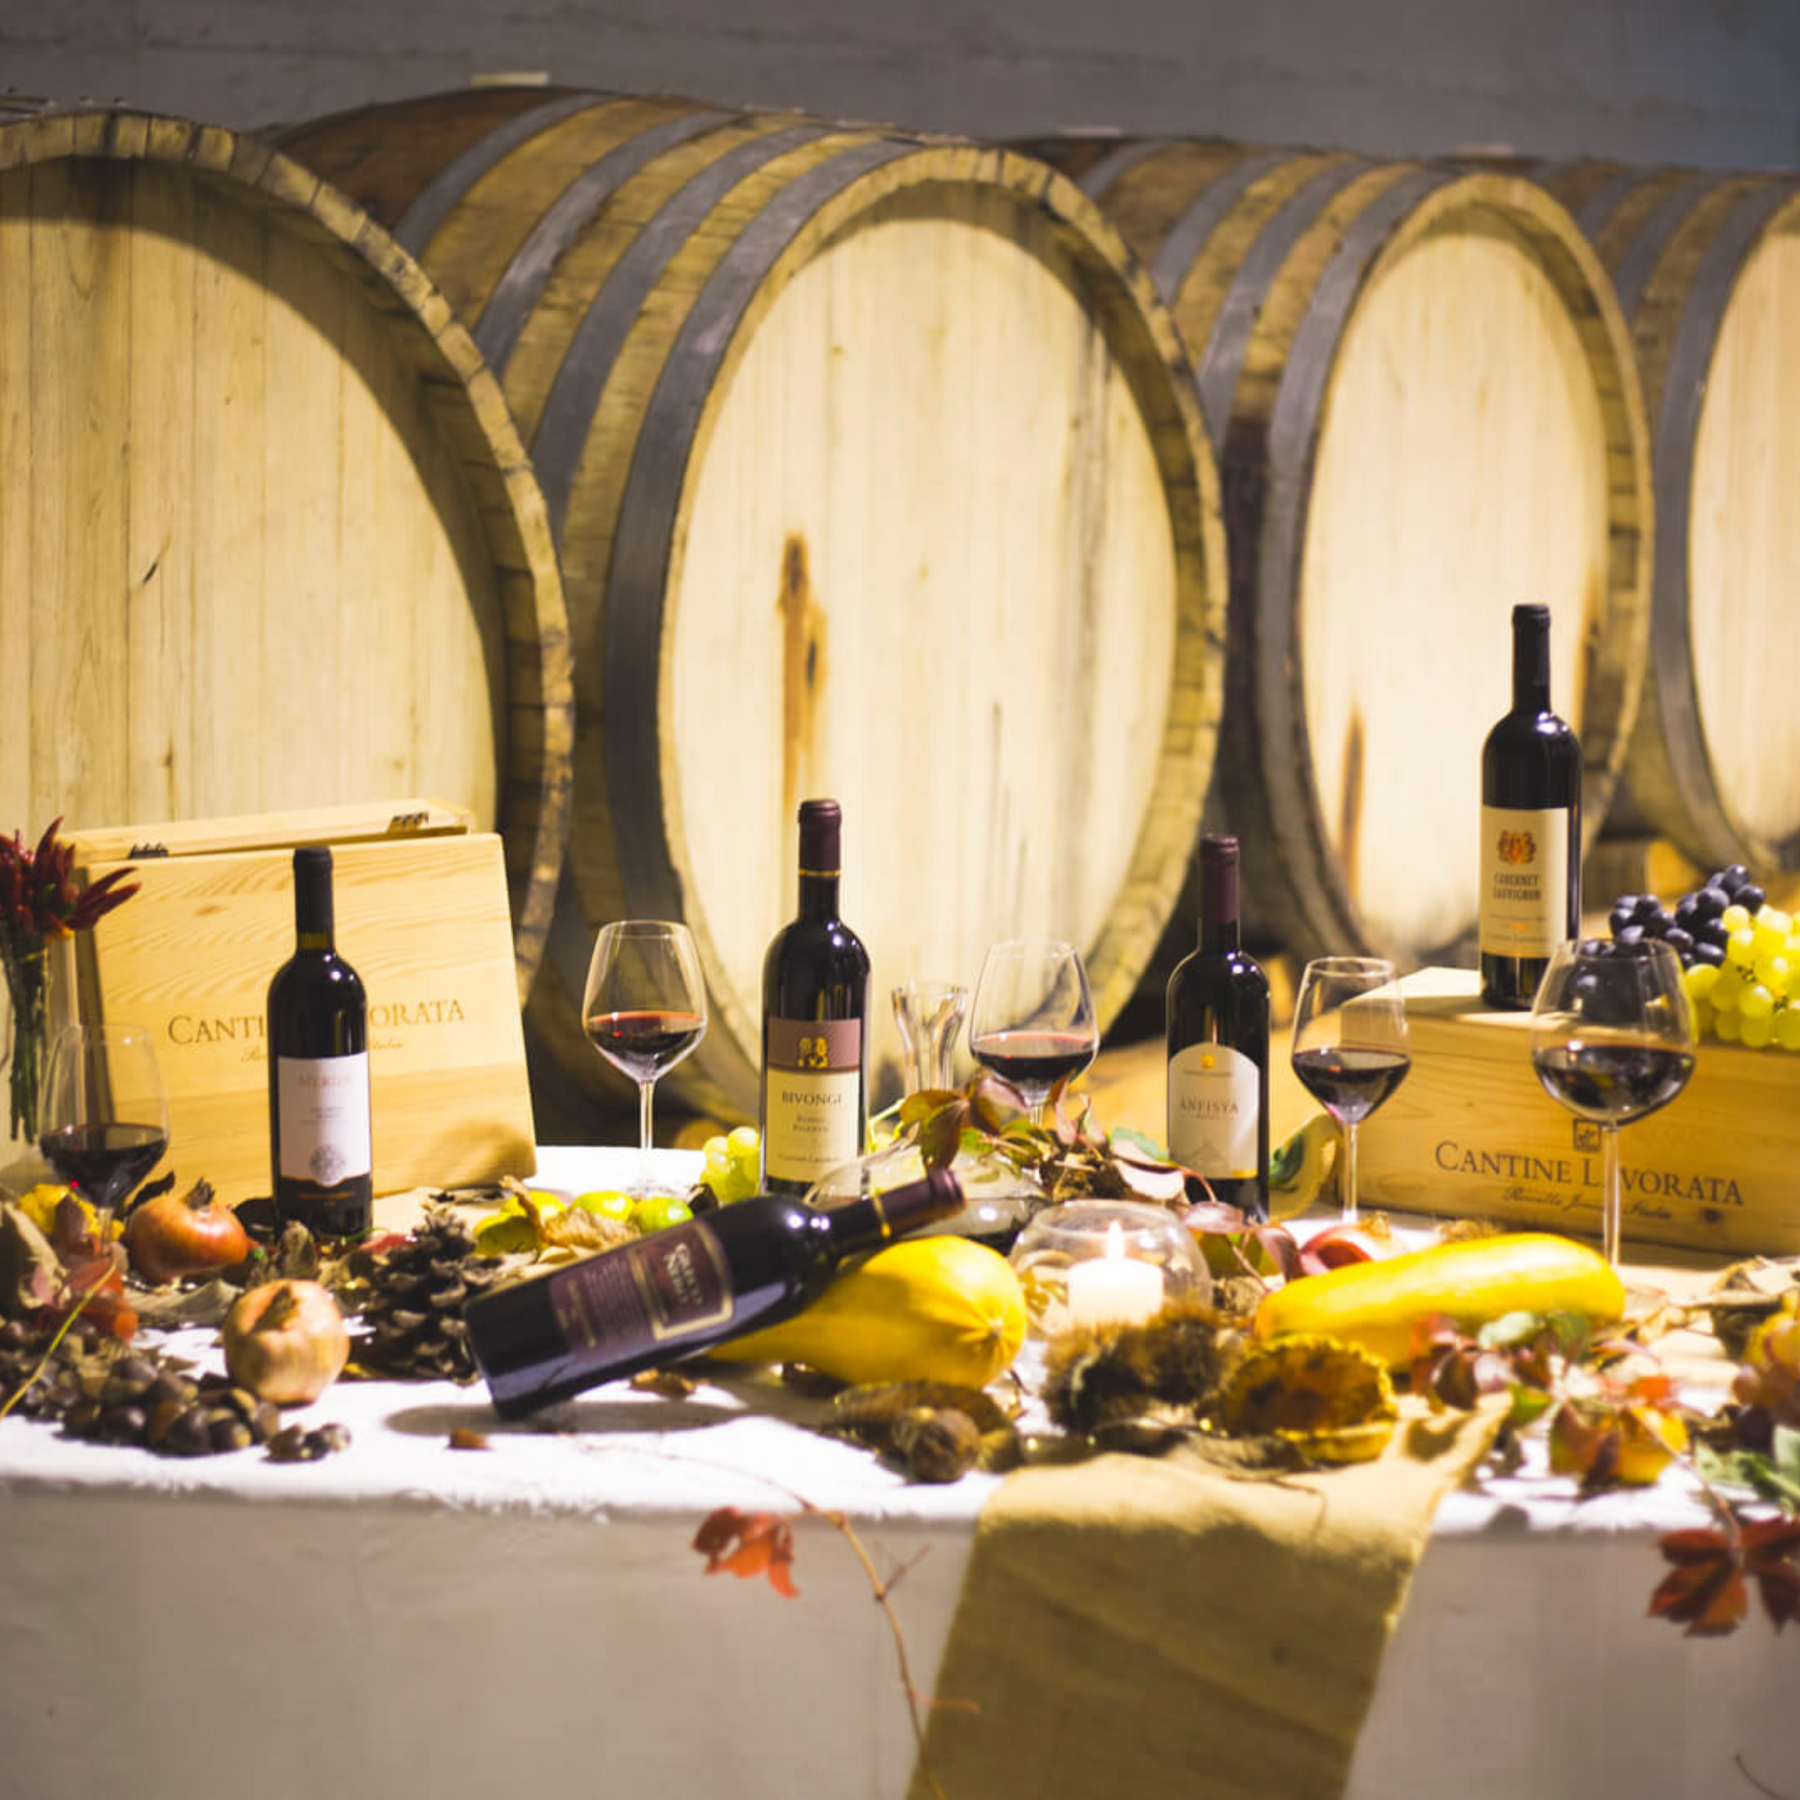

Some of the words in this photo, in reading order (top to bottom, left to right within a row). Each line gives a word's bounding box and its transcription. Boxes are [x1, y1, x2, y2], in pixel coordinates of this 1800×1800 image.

[168, 1015, 265, 1045] CANTI
[369, 998, 466, 1027] ORATA
[782, 1090, 842, 1105] BIVONGI
[1435, 1141, 1573, 1184] CANTINE
[1582, 1158, 1745, 1206] LVORATA
